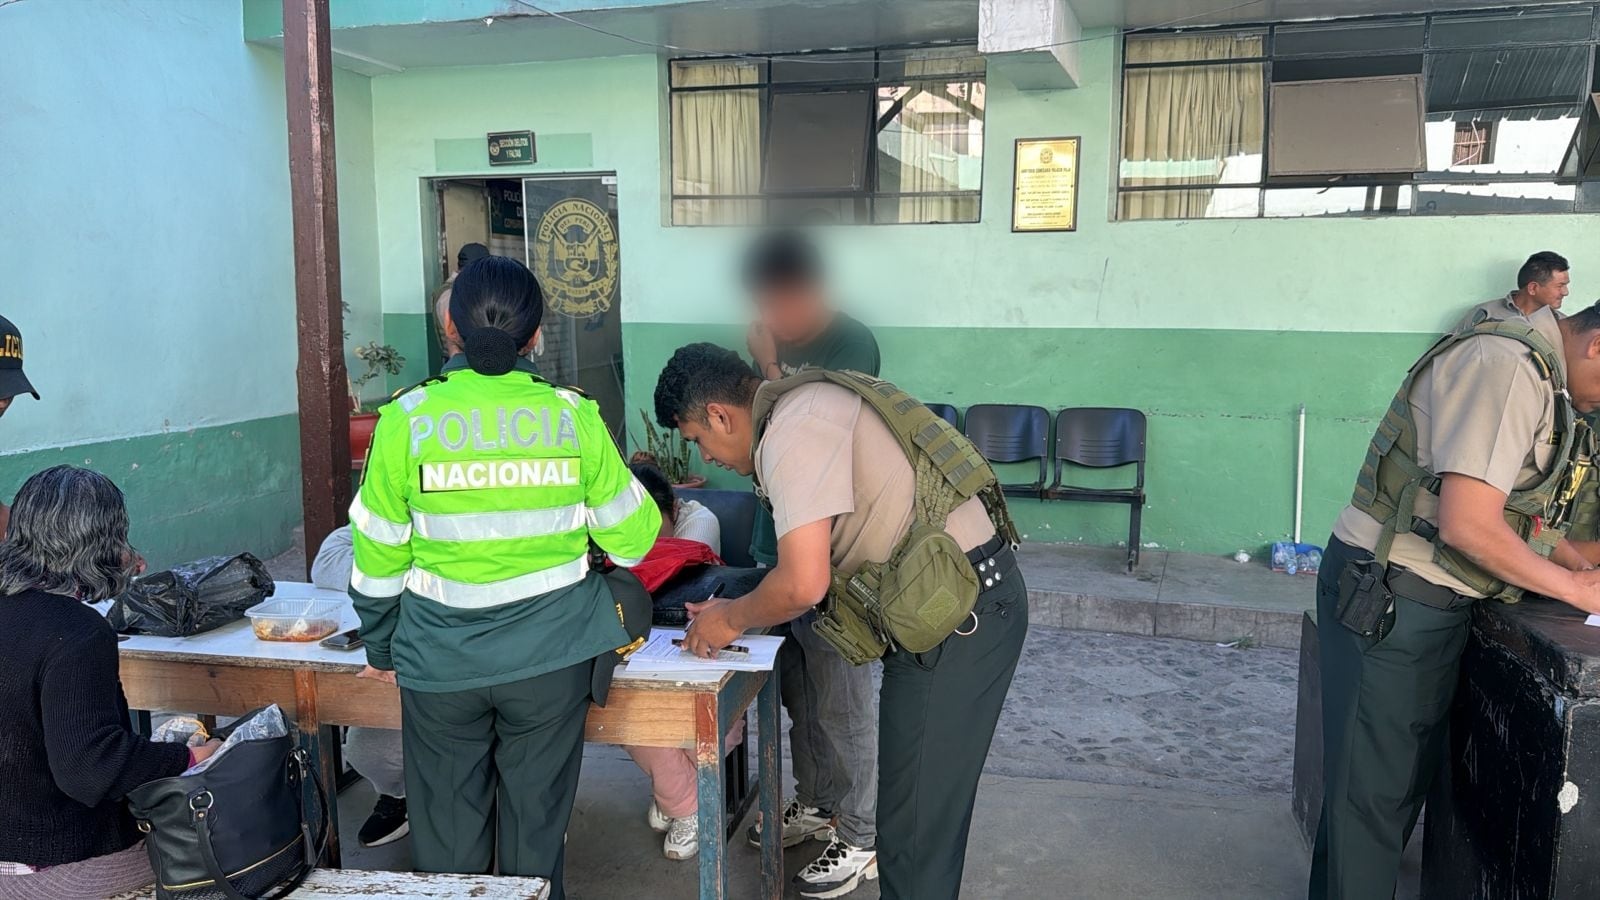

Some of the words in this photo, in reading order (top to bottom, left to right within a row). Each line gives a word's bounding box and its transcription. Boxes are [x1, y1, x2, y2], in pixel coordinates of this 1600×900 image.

[541, 205, 568, 238] POLICIA
[573, 203, 611, 237] NACIONAL
[560, 219, 571, 229] DEL
[410, 406, 579, 458] POLICIA
[423, 460, 577, 489] NACIONAL
